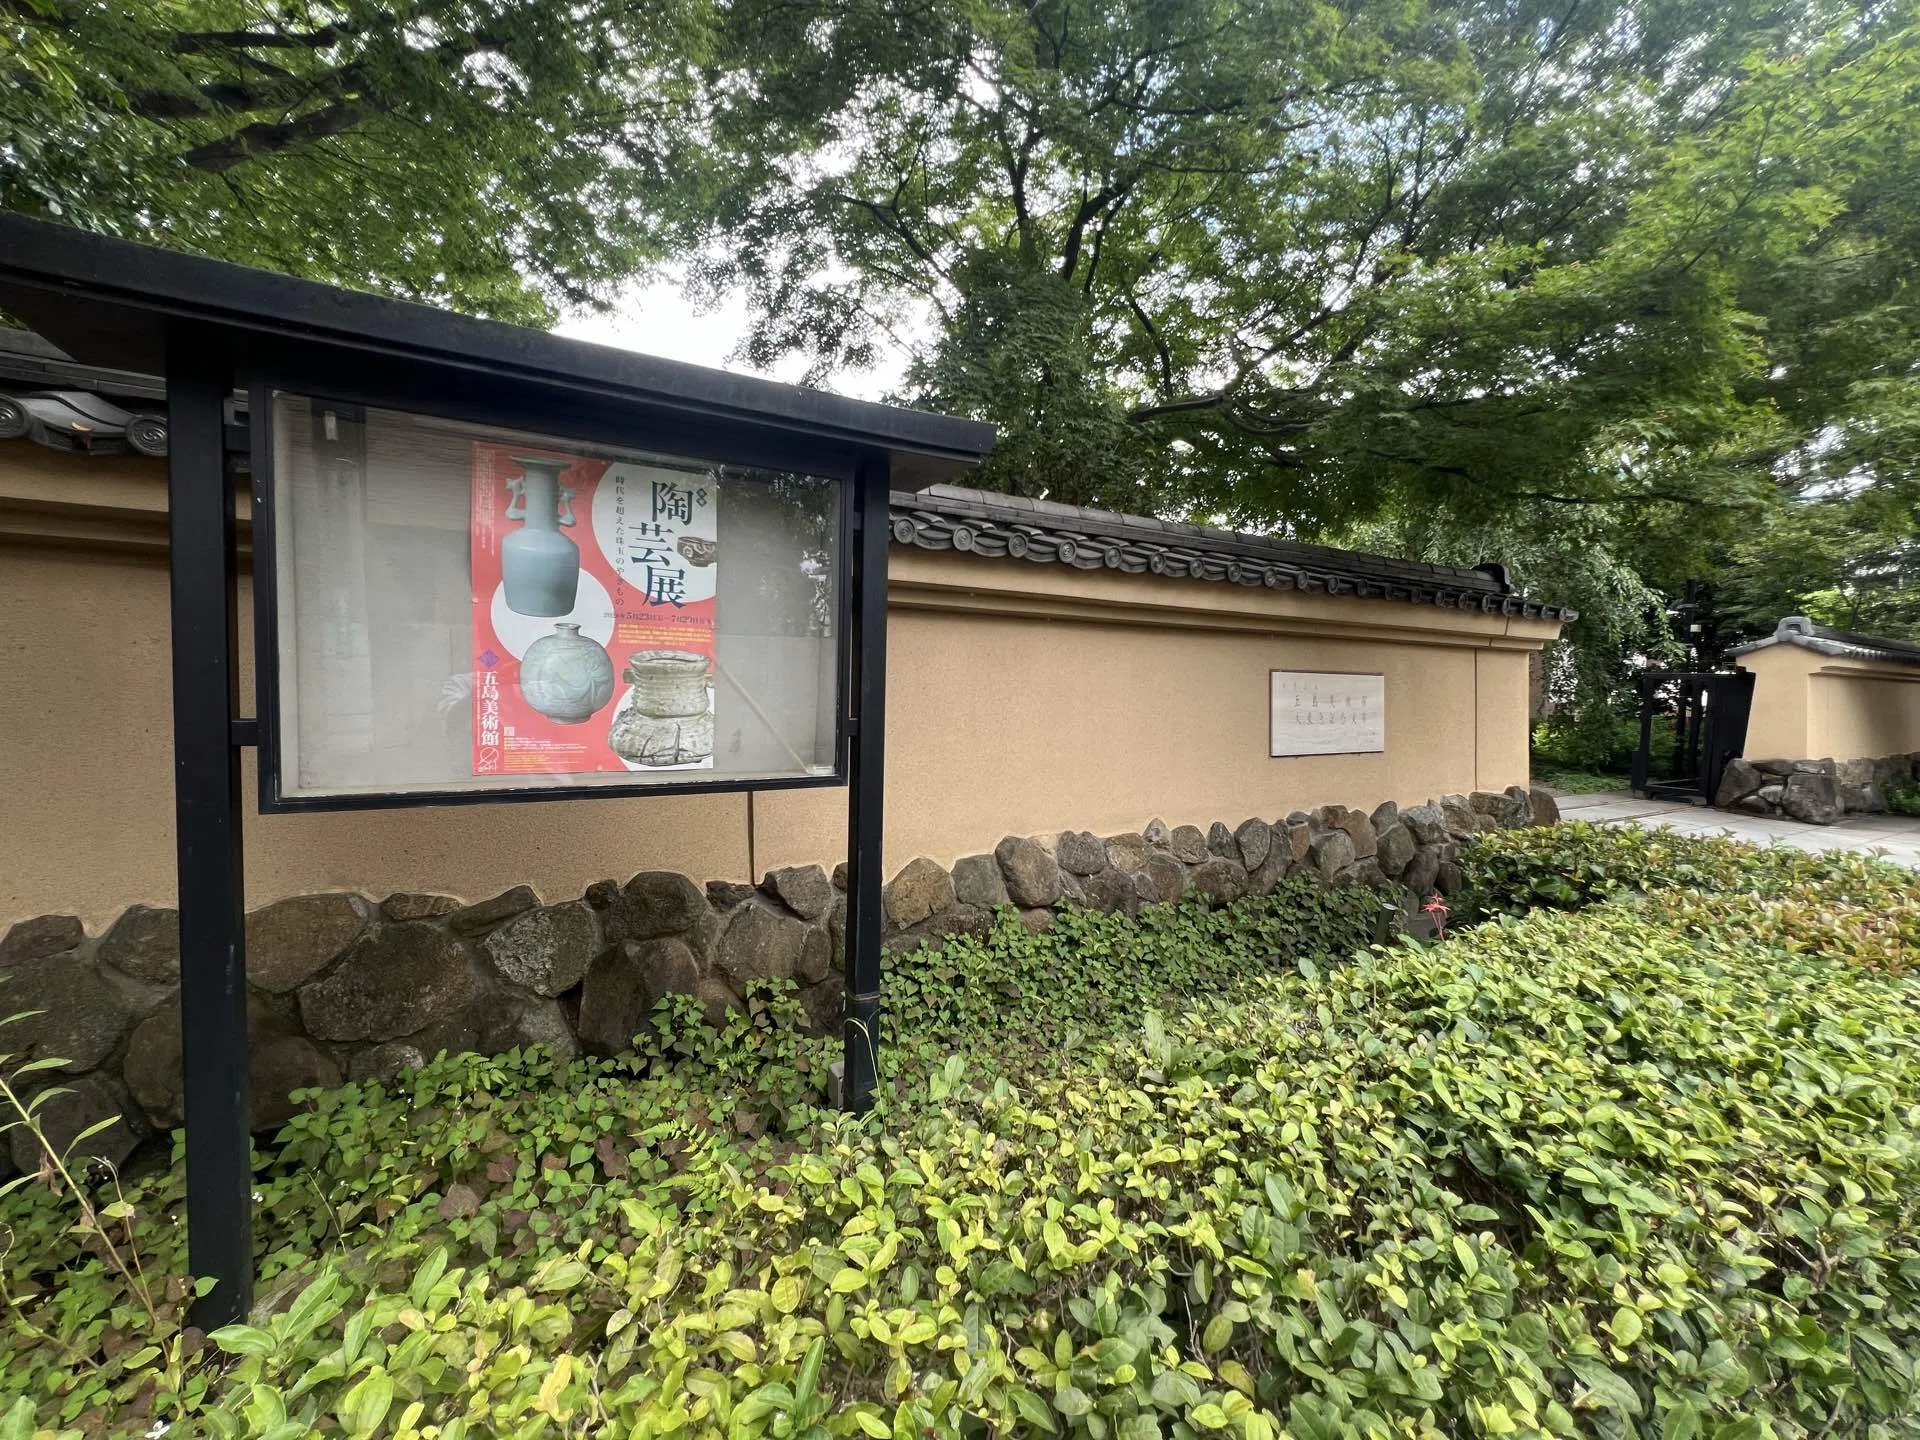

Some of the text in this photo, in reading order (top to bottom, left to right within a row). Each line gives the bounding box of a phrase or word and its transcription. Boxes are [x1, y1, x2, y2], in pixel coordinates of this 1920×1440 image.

[628, 480, 694, 609] 陶芸展
[481, 671, 500, 746] 五島美術館
